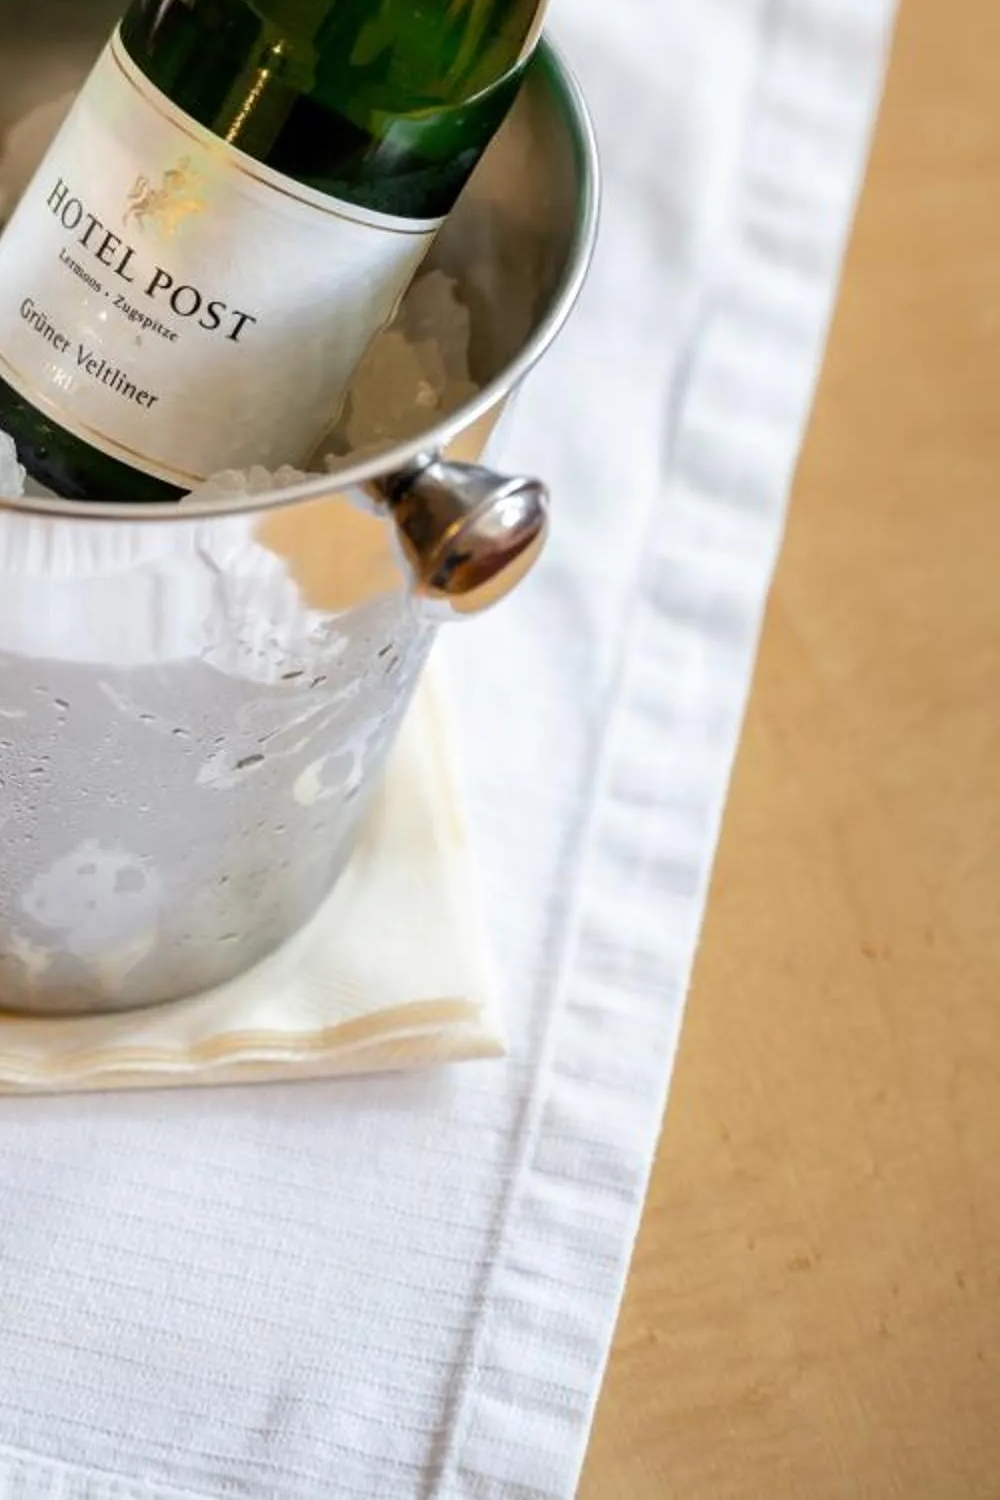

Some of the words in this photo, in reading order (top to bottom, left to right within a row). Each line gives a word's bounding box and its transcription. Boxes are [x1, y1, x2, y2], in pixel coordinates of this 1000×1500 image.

[47, 178, 136, 283] HOTEL
[144, 266, 256, 343] POST
[20, 297, 71, 353] Grüner
[77, 344, 159, 409] Veltliner
[112, 294, 179, 342] Zugspitze
